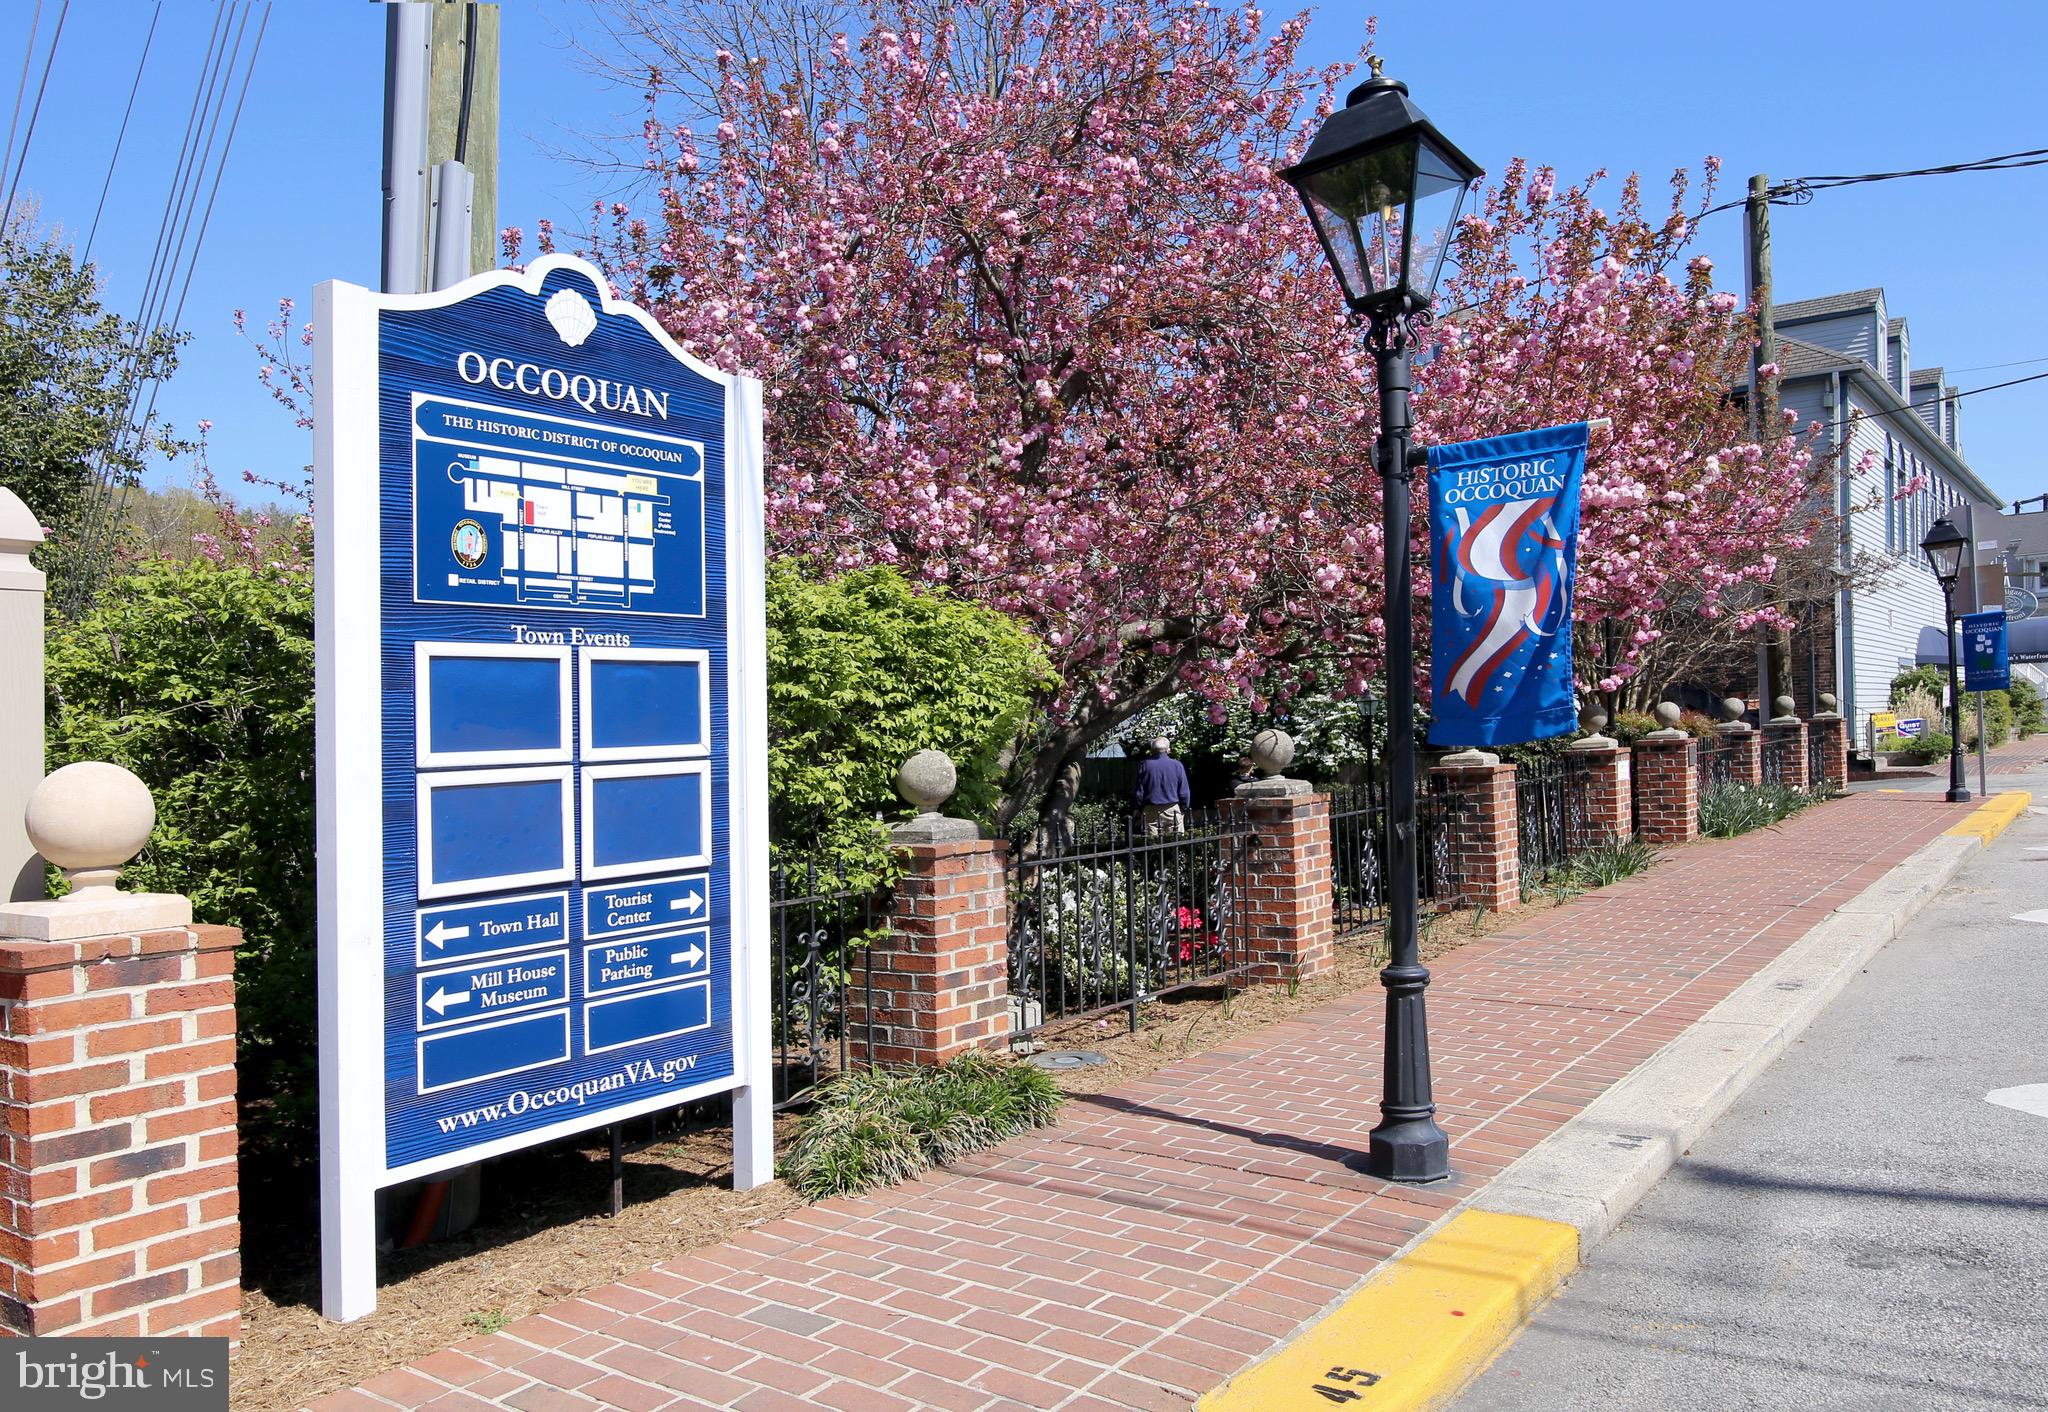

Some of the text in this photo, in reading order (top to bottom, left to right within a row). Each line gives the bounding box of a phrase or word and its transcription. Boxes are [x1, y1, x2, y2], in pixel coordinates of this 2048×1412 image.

[457, 351, 669, 421] OCCOQUAN
[443, 413, 683, 463] THE HISTORIC DISTRICT OF OCCOQUAN
[1457, 459, 1555, 487] HISTORIC
[1445, 475, 1566, 504] OCCOQUAN
[477, 578, 500, 586] DISTRICT
[509, 624, 631, 648] Town Events
[1965, 626, 2004, 634] OCCOQUAN
[1968, 621, 1999, 629] HISTORIC
[605, 891, 653, 909] Tourist
[480, 912, 560, 937] Town Hall
[607, 910, 652, 928] Center
[605, 946, 649, 964] Public
[471, 963, 556, 991] Mill House
[601, 963, 653, 983] Parking
[480, 985, 548, 1009] Museum
[436, 1054, 698, 1135] www.OccoquanVA.gov
[1311, 1366, 1381, 1404] 45
